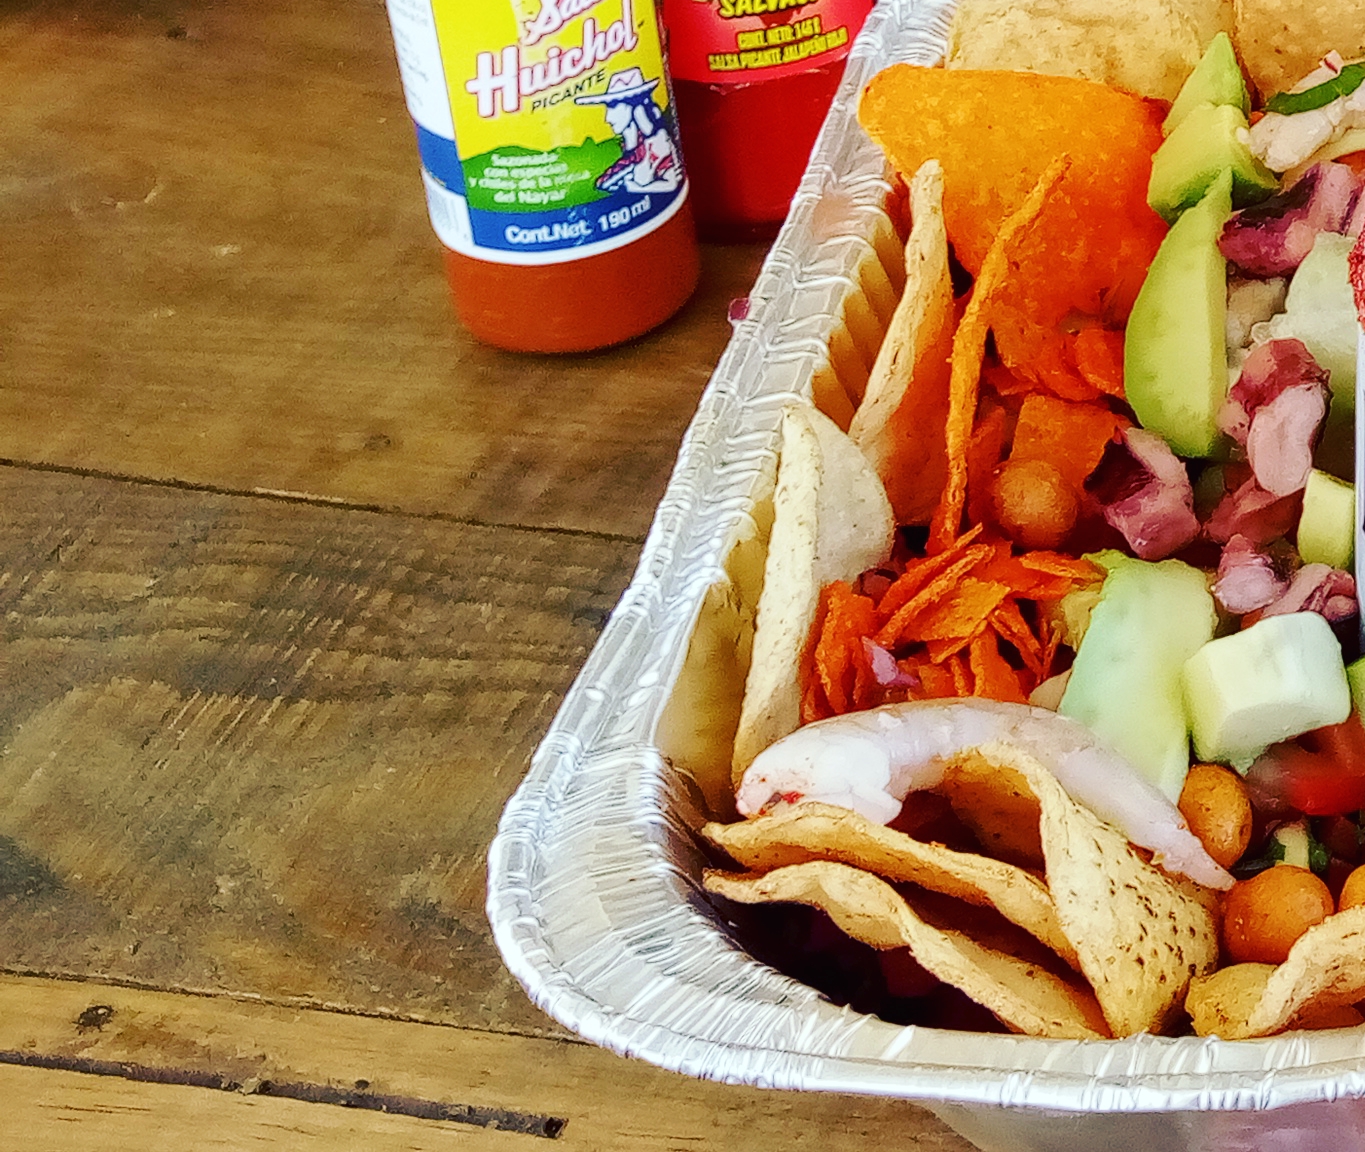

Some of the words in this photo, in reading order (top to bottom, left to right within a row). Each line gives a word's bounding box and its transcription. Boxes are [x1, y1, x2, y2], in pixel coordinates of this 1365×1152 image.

[531, 67, 607, 113] PICANTE
[599, 206, 631, 232] 190
[632, 195, 651, 218] ml
